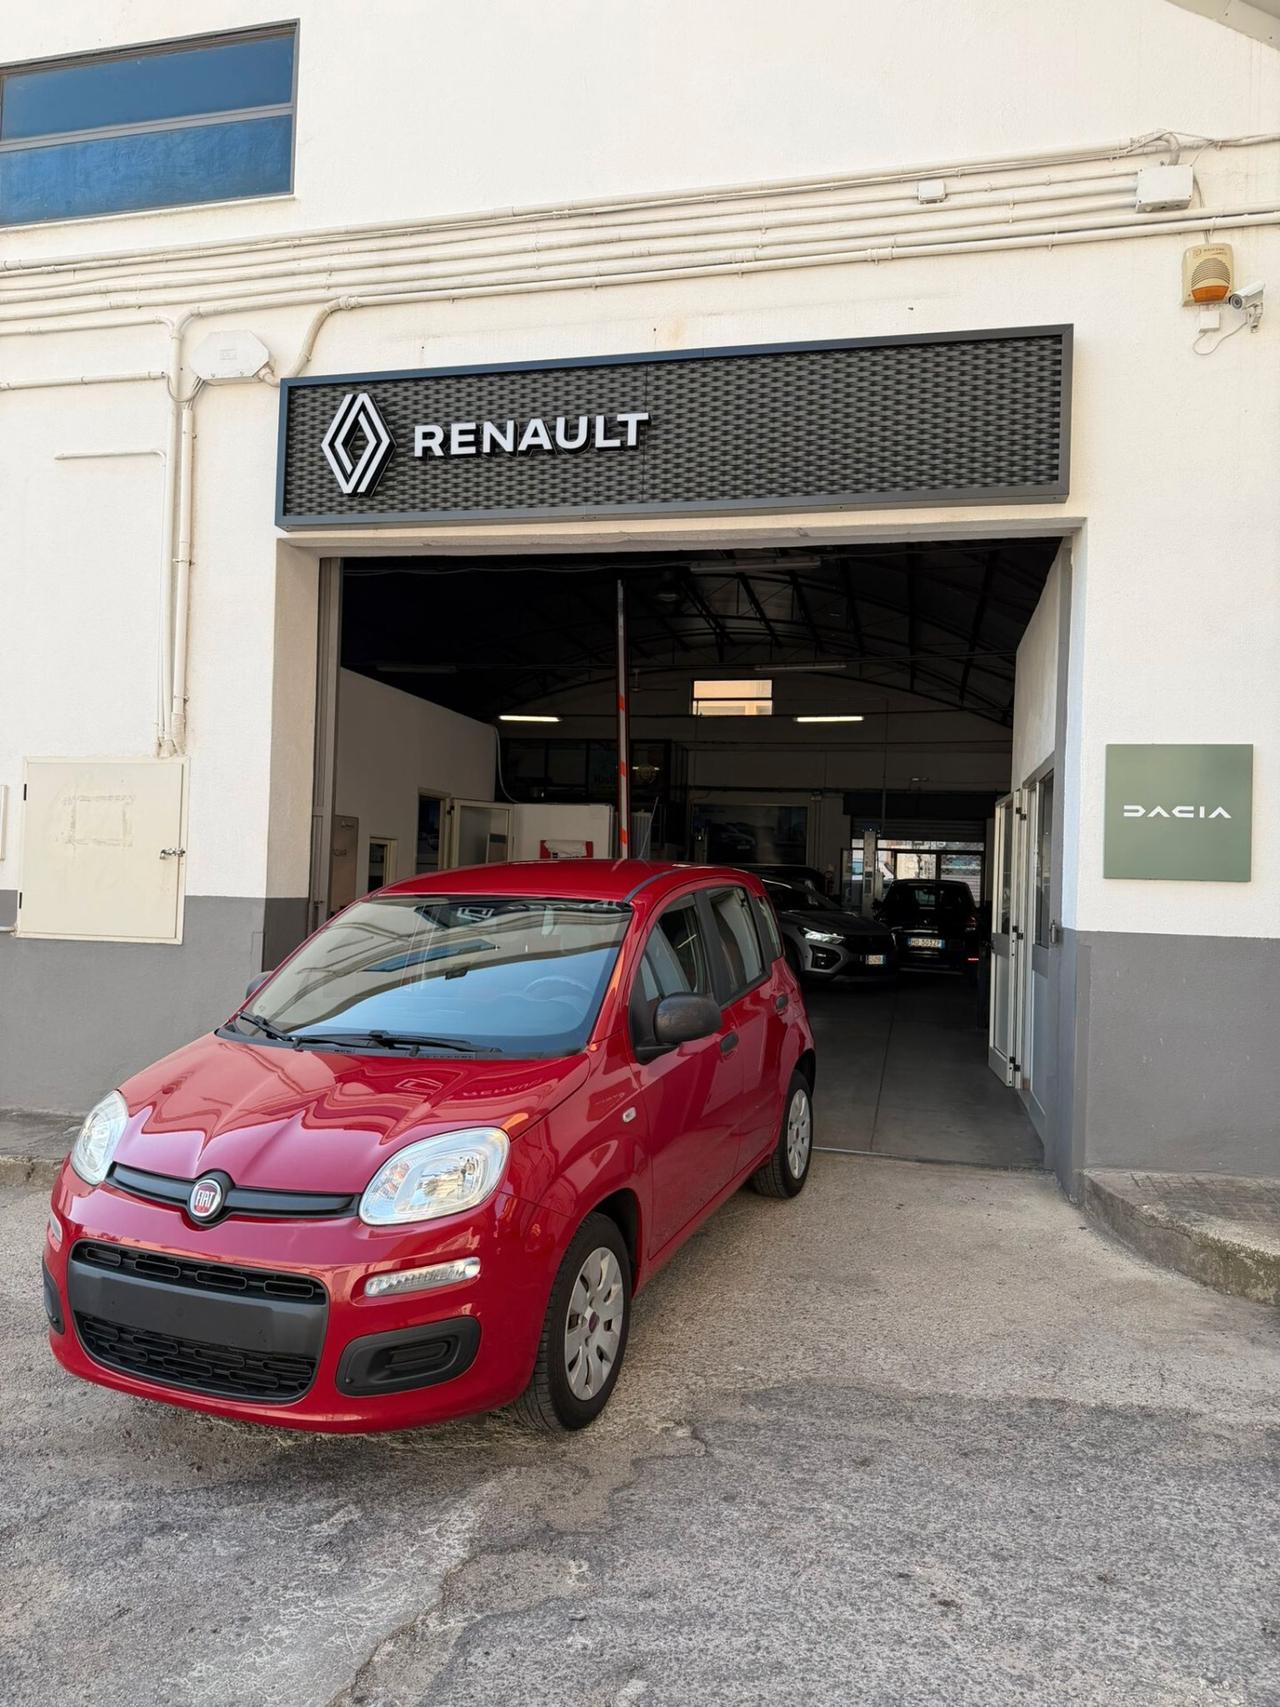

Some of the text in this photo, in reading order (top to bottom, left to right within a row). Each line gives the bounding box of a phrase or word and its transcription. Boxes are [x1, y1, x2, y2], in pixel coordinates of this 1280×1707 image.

[414, 412, 649, 457] RENAULT
[1123, 805, 1232, 819] DACIA
[195, 1190, 216, 1208] FIAT
